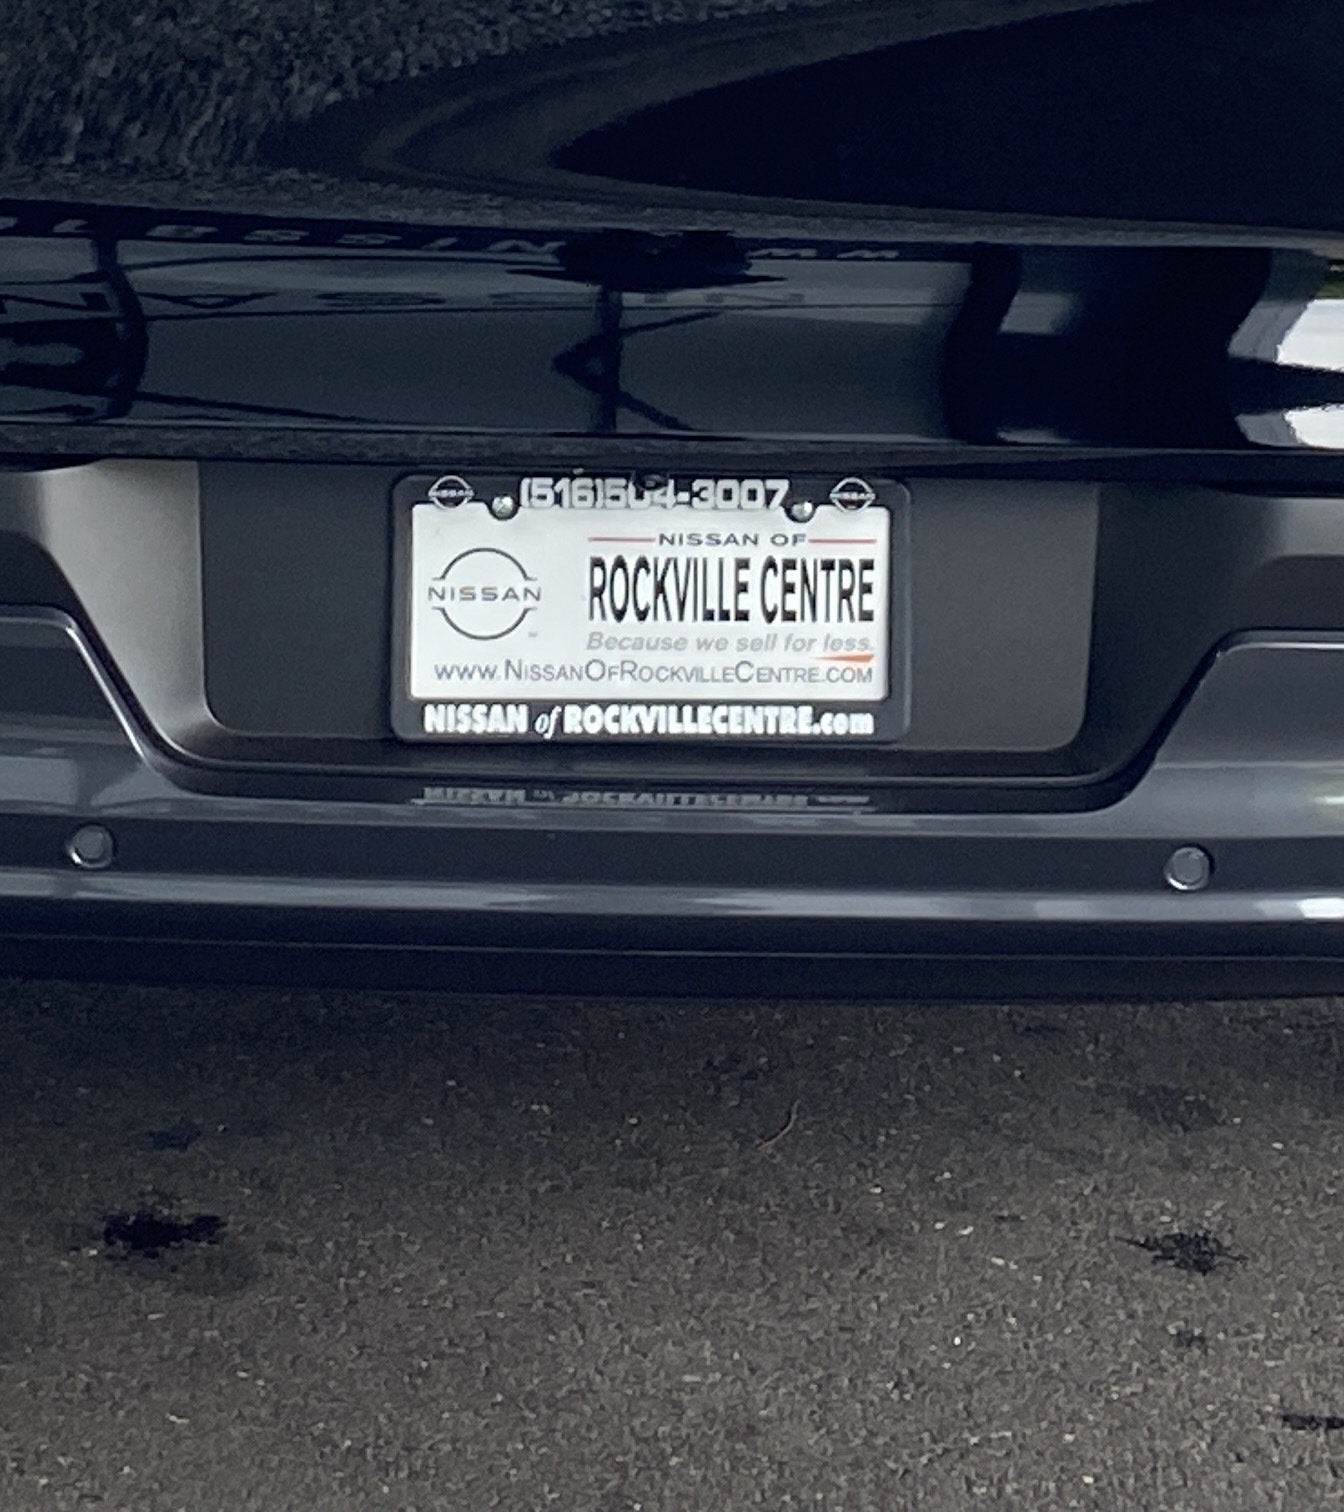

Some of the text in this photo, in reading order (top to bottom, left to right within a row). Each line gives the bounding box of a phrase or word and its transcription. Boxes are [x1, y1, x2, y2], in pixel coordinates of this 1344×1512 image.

[658, 532, 807, 547] NISSAN OF
[427, 585, 542, 602] NISSAN
[587, 555, 875, 624] ROCKVILLE CENTRE
[586, 631, 688, 652] Because
[695, 637, 729, 652] we
[735, 633, 777, 652] sell
[783, 633, 817, 652] for
[423, 703, 875, 739] NISSAN of ROCKVILLECENTRE.com
